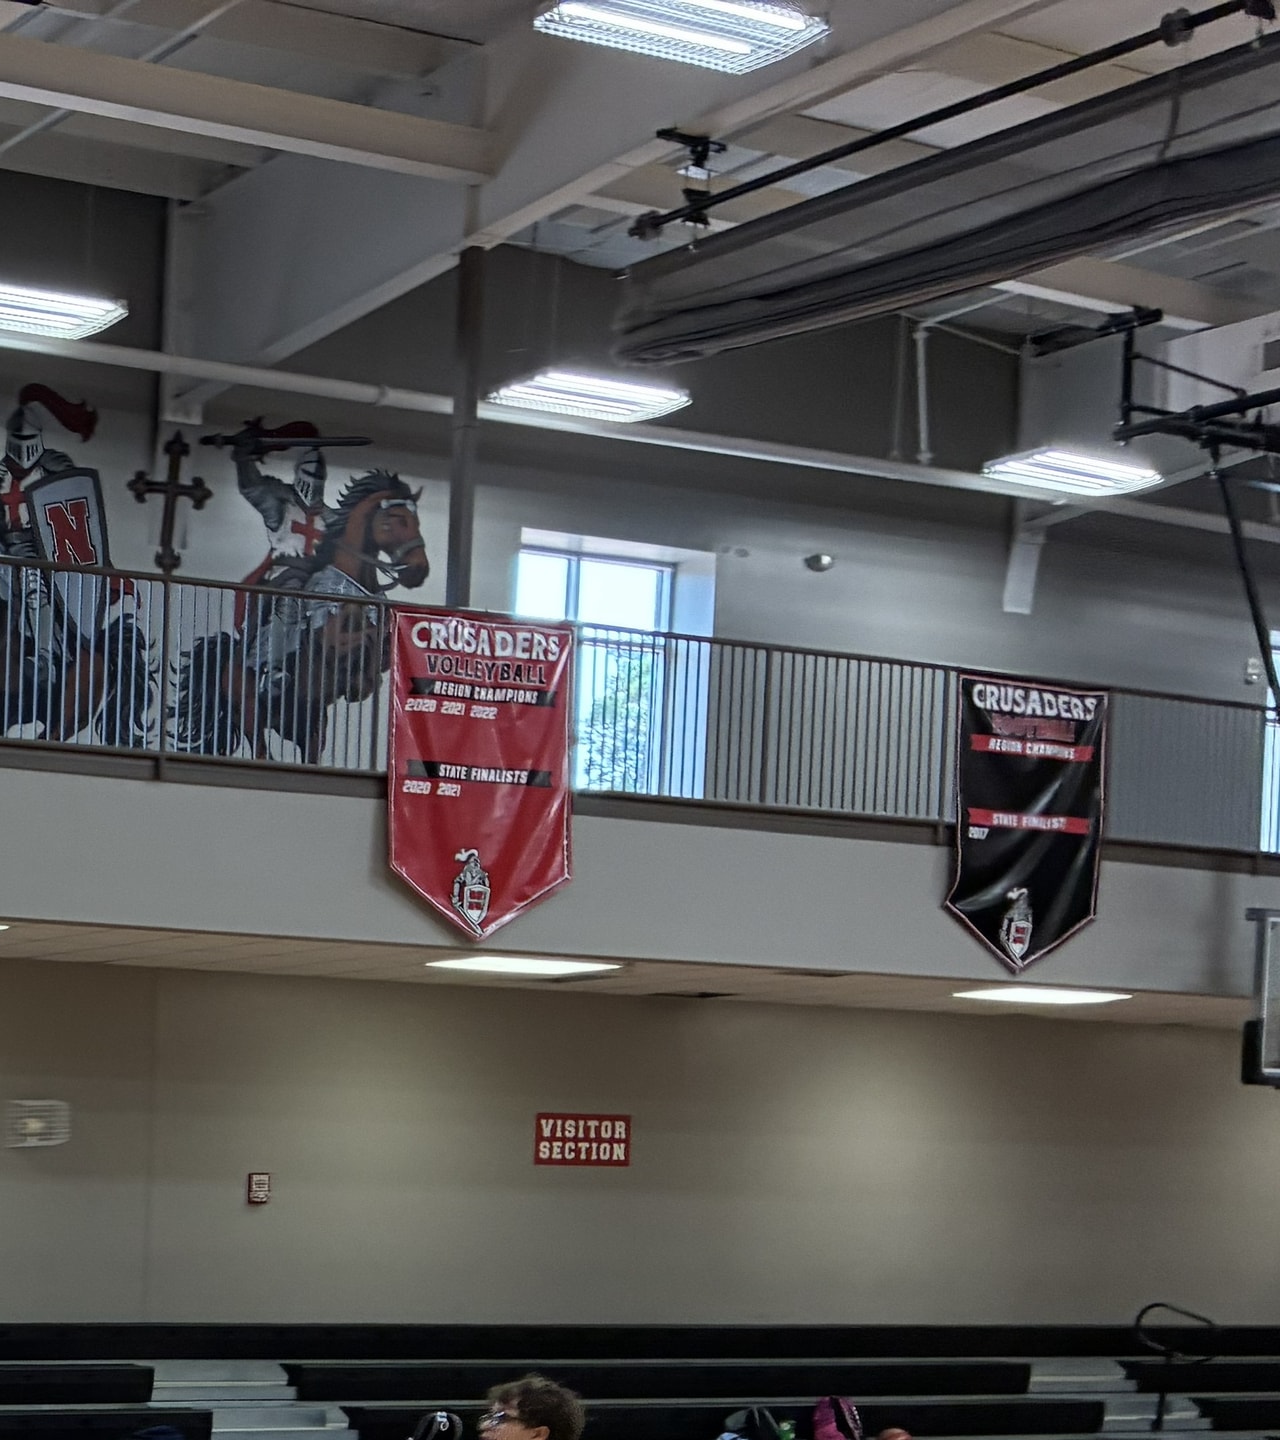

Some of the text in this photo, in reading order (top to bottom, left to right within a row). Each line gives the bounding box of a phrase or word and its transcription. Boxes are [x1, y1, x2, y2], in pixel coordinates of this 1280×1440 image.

[44, 497, 98, 566] N
[411, 620, 560, 662] CRUSADERS
[426, 655, 547, 686] VOLLEYBALL
[434, 681, 538, 705] REGION CHAMPIONS
[972, 683, 1097, 721] CRUSADERS
[439, 763, 528, 785] STATE FINALISTS
[540, 1118, 626, 1139] VISITOR
[539, 1140, 626, 1161] SECTION
